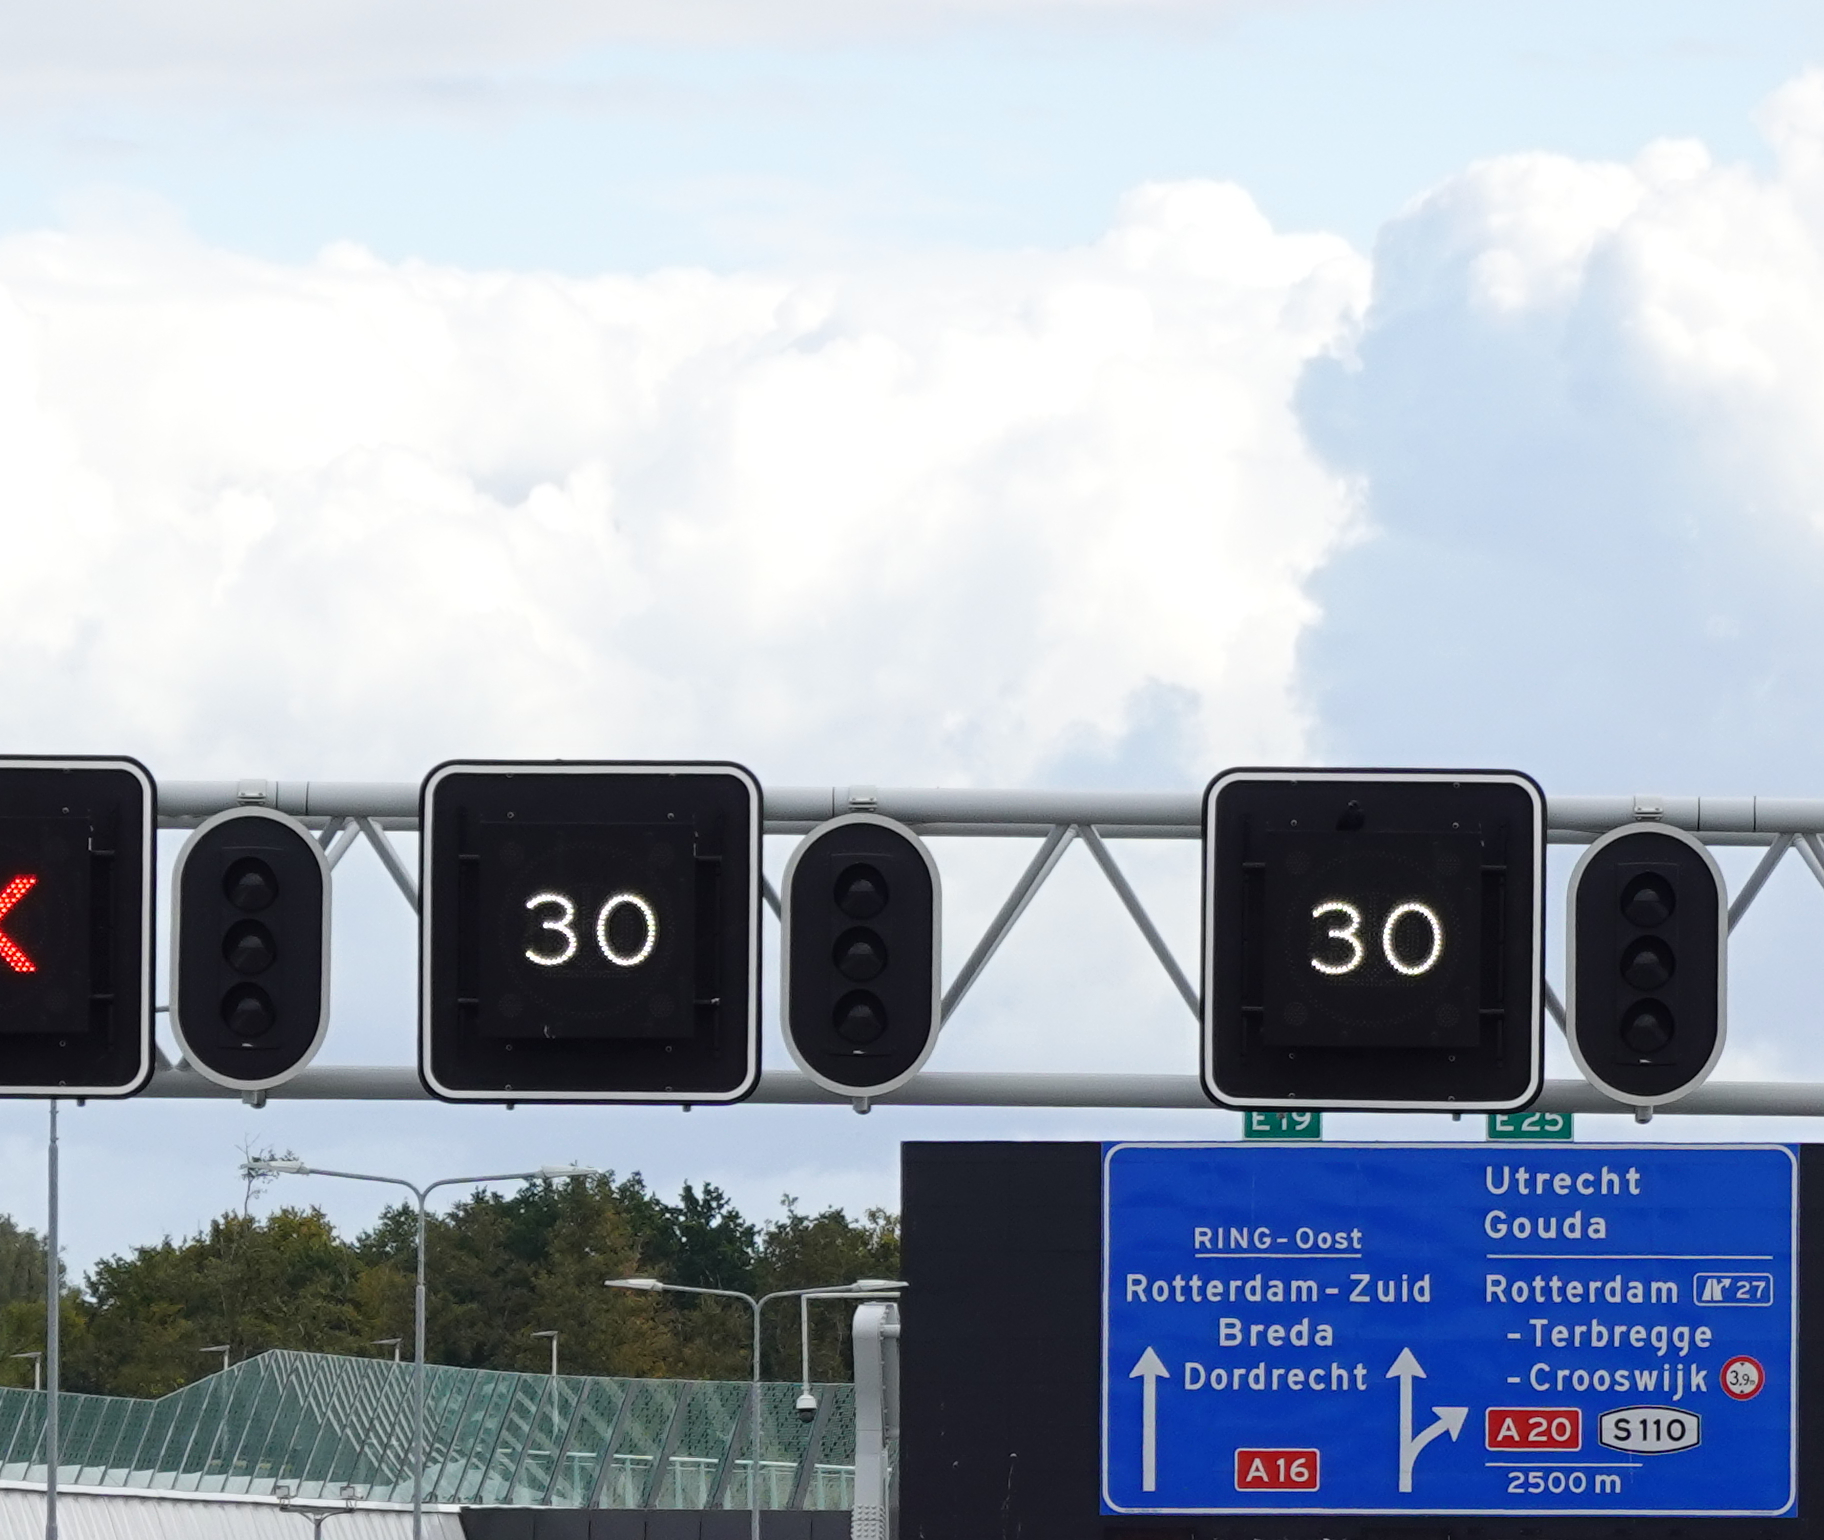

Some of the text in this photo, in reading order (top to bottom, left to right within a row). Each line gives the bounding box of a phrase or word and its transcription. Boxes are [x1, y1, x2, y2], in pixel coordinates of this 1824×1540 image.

[523, 891, 659, 968] 30
[1309, 900, 1444, 977] 30
[1485, 1165, 1642, 1196] Utrecht
[1193, 1226, 1364, 1250] RING-Oost
[1484, 1209, 1608, 1240] Gouda
[1125, 1272, 1432, 1303] Rotterdam-Zuid
[1484, 1273, 1679, 1304] Rotterdam
[1736, 1280, 1767, 1300] 27
[1218, 1317, 1334, 1348] Breda
[1506, 1318, 1713, 1358] -Terbregge
[1183, 1361, 1369, 1392] Dordrecht
[1506, 1362, 1709, 1402] -Crooswijk
[1506, 1471, 1622, 1495] 2500 m
